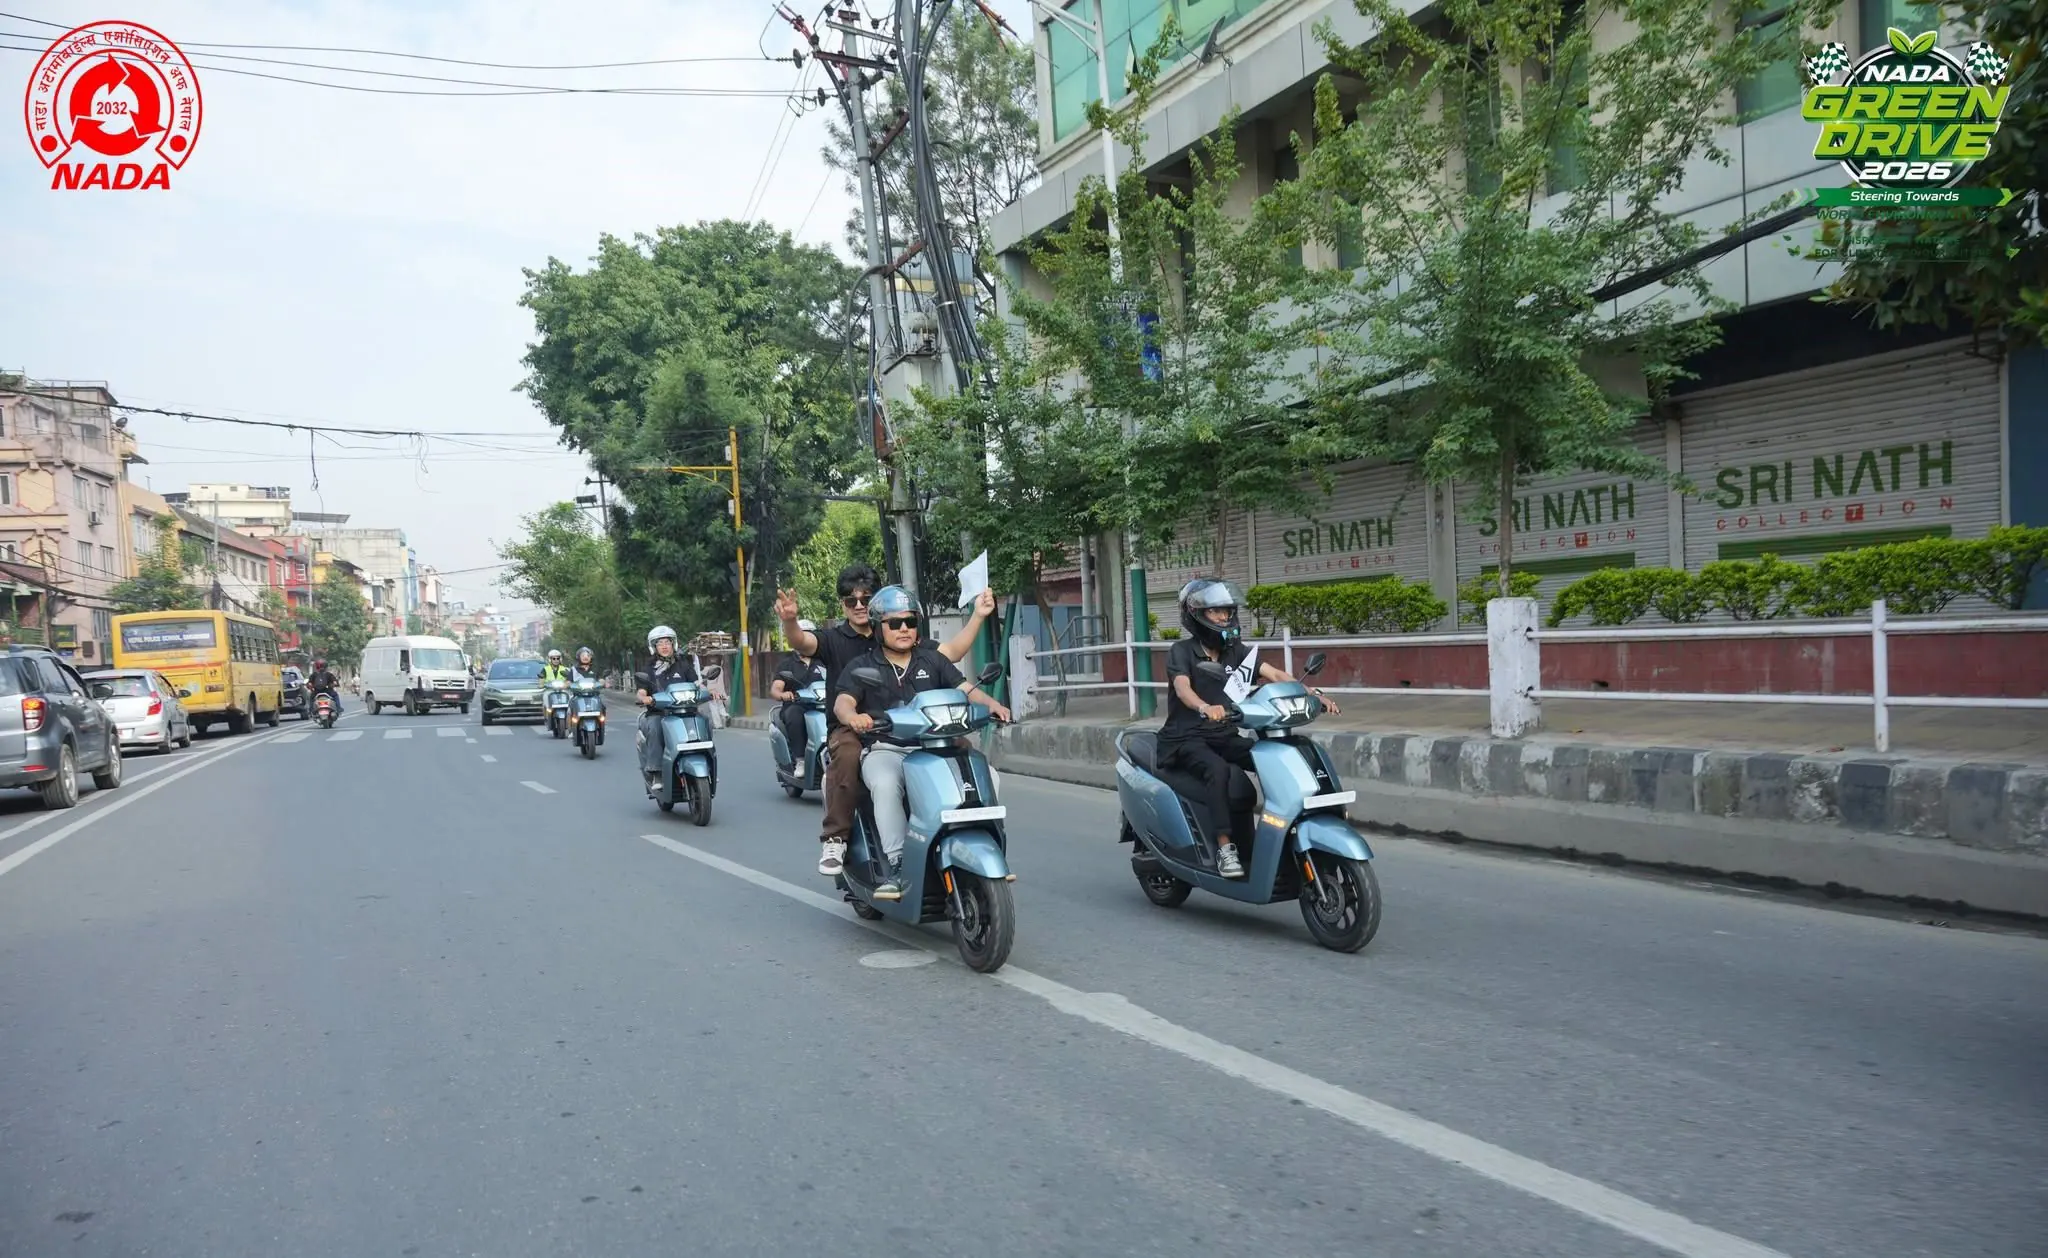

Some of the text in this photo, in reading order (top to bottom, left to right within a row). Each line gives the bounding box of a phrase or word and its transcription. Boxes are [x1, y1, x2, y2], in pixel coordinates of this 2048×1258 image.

[1716, 440, 1953, 509] SRI NATH
[1543, 483, 1635, 530] NATH
[1717, 497, 1953, 531] COLLECTION
[1283, 519, 1393, 558] SRI NATH
[1480, 529, 1636, 555] COLECTION
